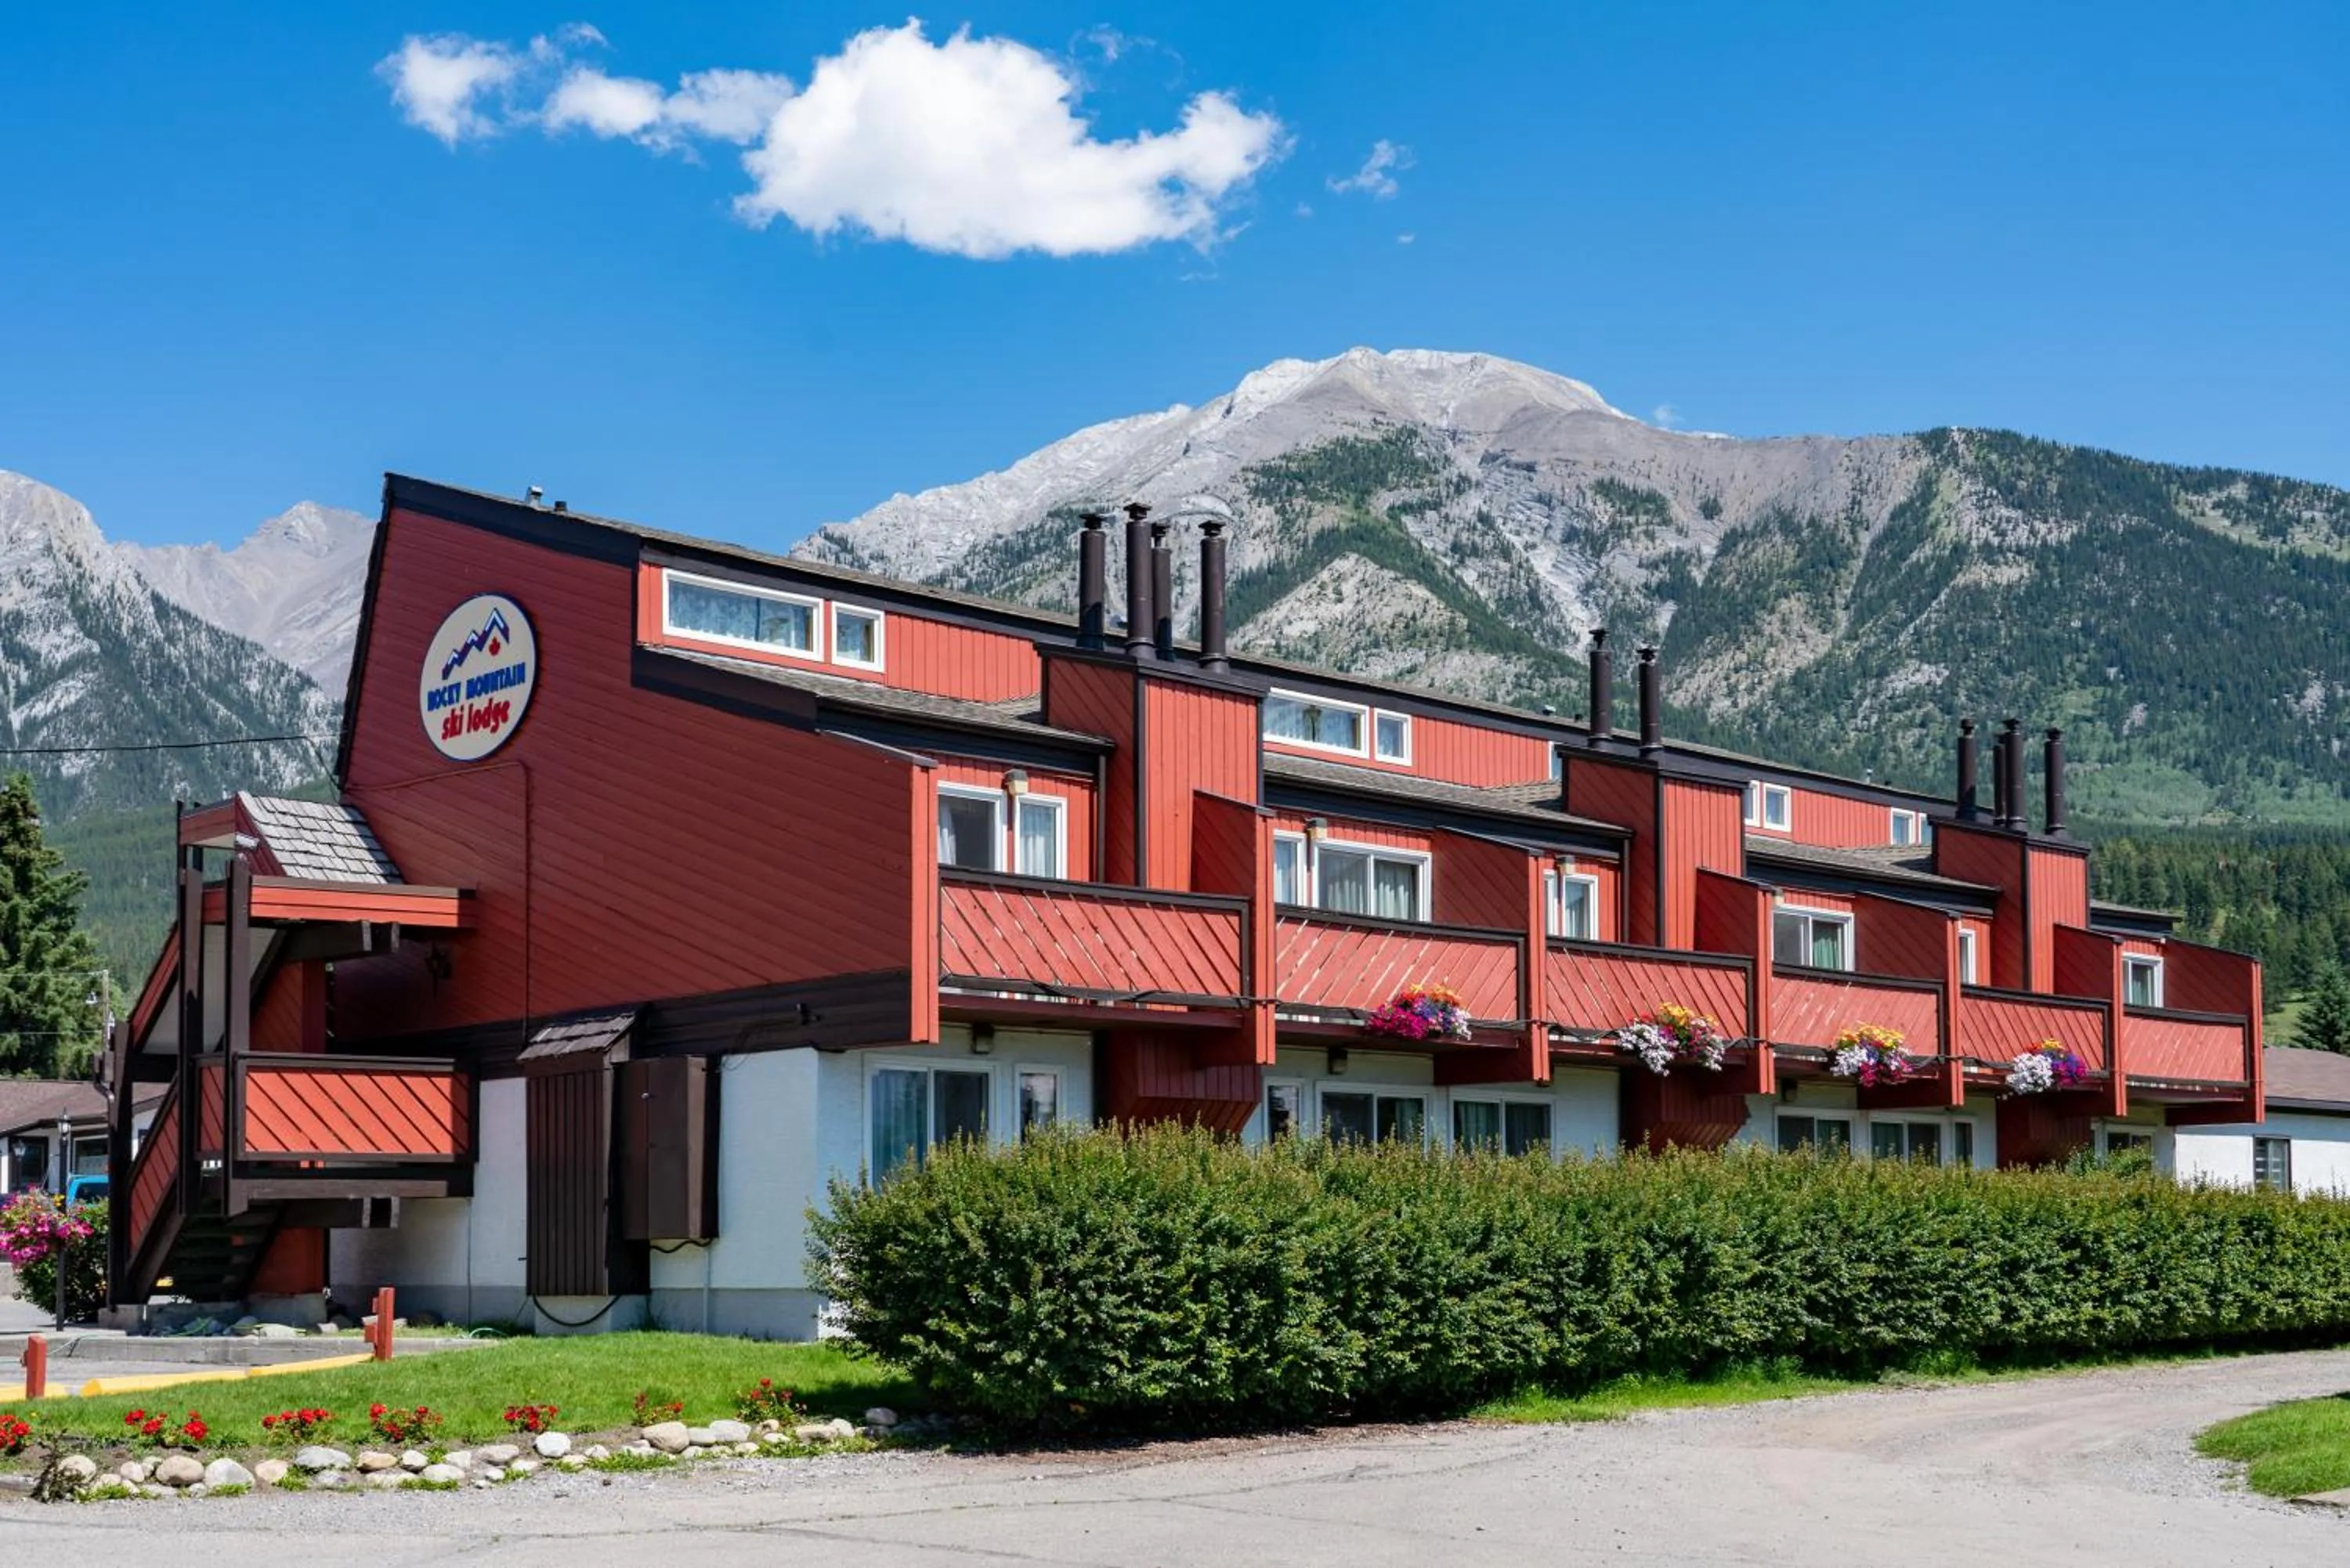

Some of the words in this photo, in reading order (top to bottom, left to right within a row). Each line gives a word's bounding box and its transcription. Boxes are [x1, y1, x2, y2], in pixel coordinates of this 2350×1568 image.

[428, 682, 461, 711] ROCKY
[466, 663, 525, 699] MOUNTAIN
[442, 706, 464, 740] ski
[467, 698, 511, 733] lodge
